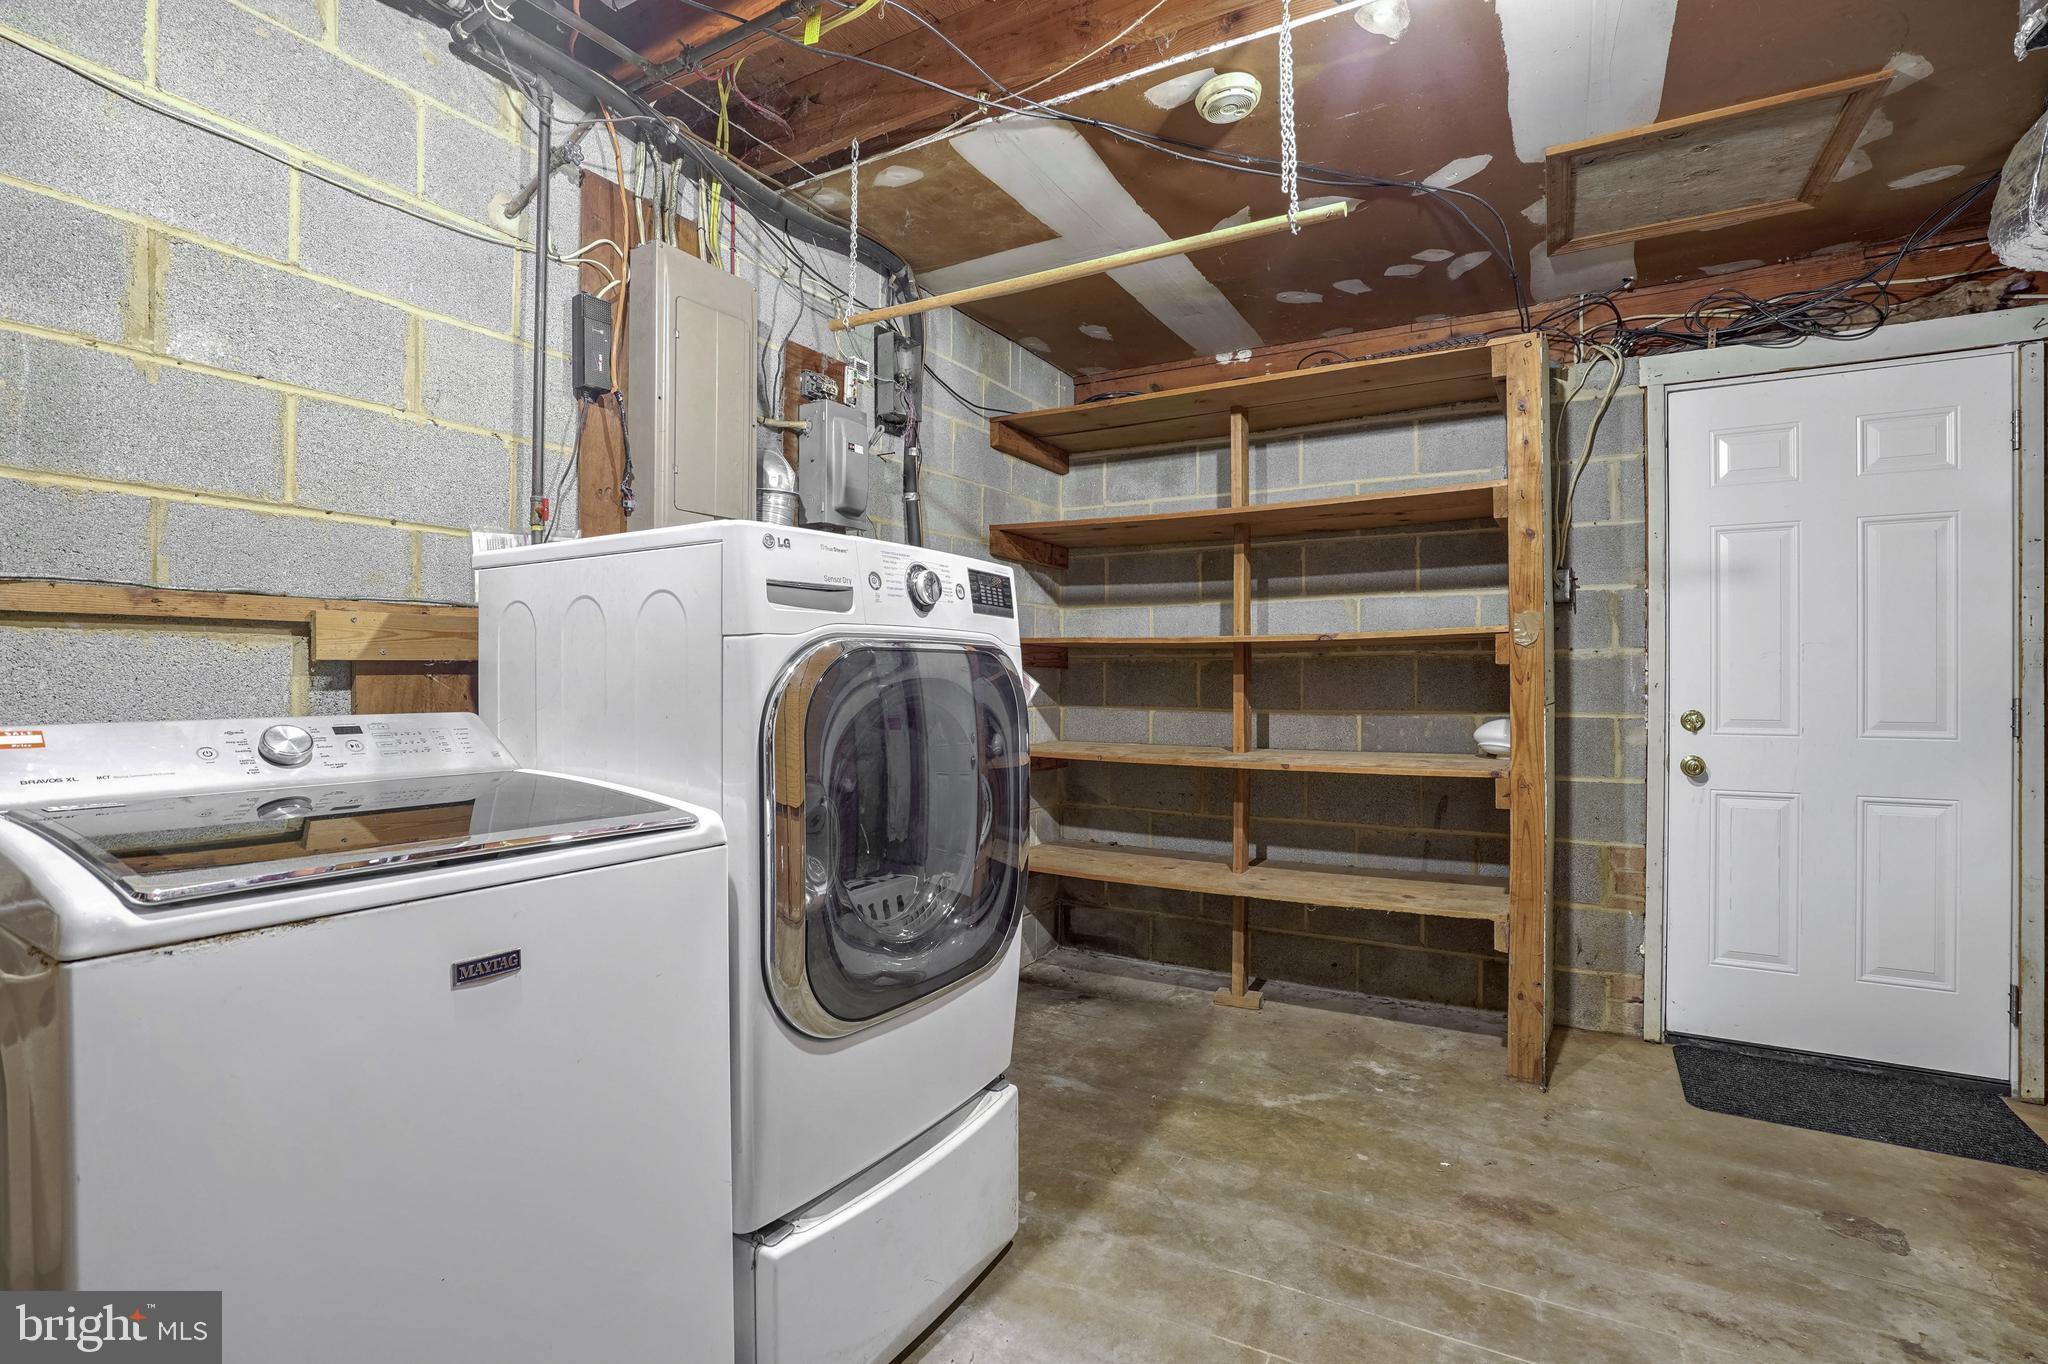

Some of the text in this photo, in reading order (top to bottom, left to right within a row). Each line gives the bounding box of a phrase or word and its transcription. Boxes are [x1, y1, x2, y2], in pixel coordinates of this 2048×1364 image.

[777, 537, 791, 549] LG
[823, 575, 852, 586] Sensor Dry
[459, 953, 519, 980] MAYTAG
